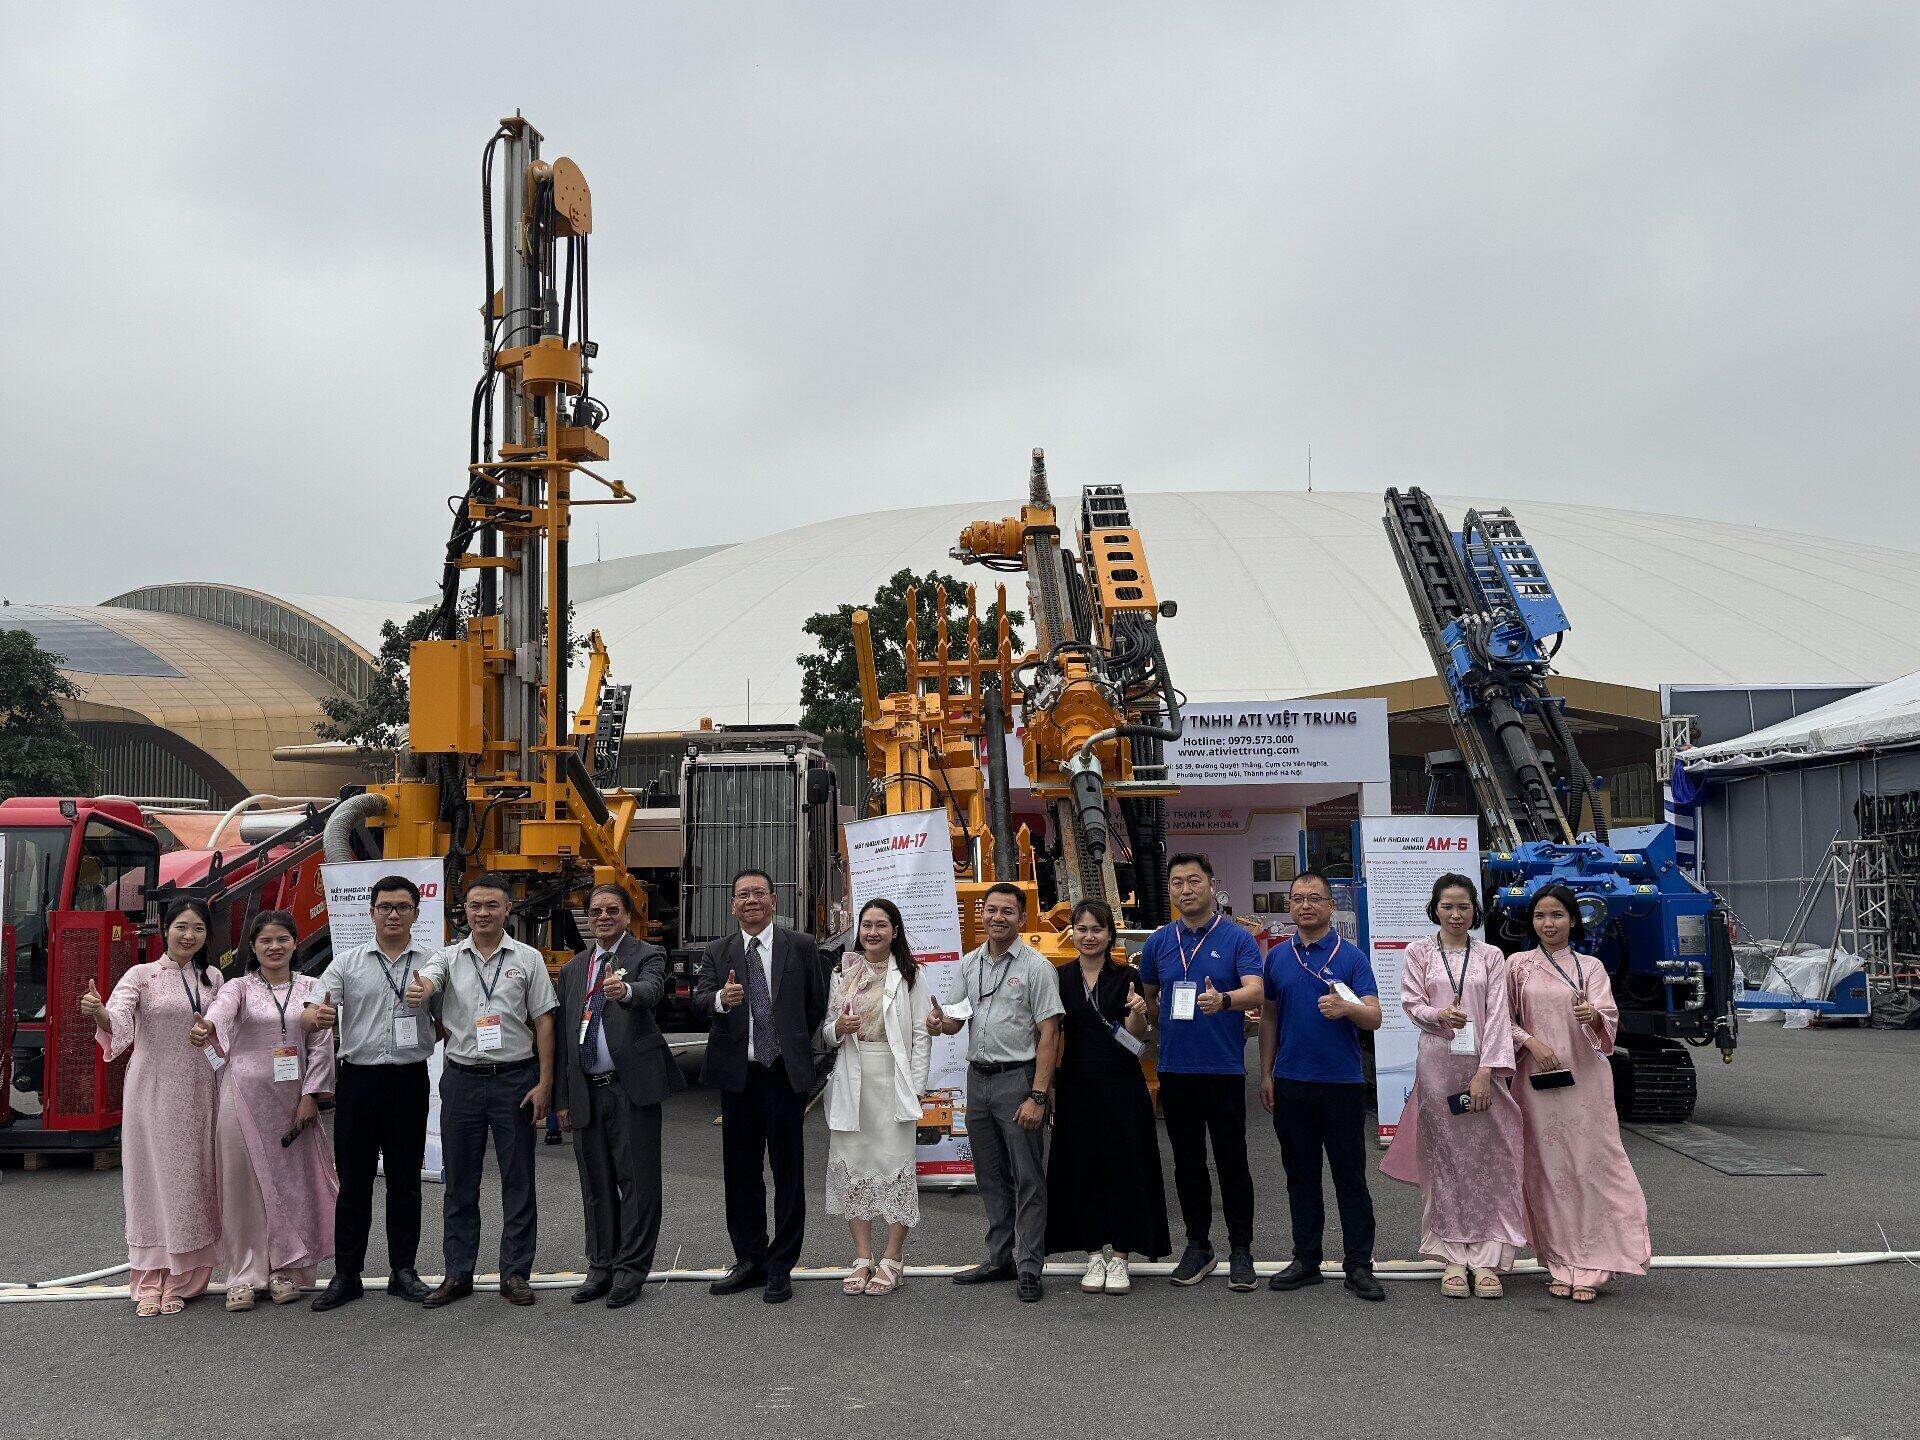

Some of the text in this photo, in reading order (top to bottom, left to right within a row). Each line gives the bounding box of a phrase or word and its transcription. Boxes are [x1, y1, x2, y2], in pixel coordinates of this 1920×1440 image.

[1189, 714, 1233, 728] TNHH
[1237, 714, 1263, 727] ATI
[1266, 709, 1300, 728] VIỆT
[1303, 711, 1357, 725] TRUNG
[1183, 735, 1294, 746] Hotline: 0979.573.000
[1178, 746, 1299, 757] www.ativiettrung.com
[1172, 820, 1205, 829] NGÀNH
[1207, 821, 1239, 829] KHOAN
[890, 833, 928, 851] AM-17
[1425, 836, 1468, 851] AM-6
